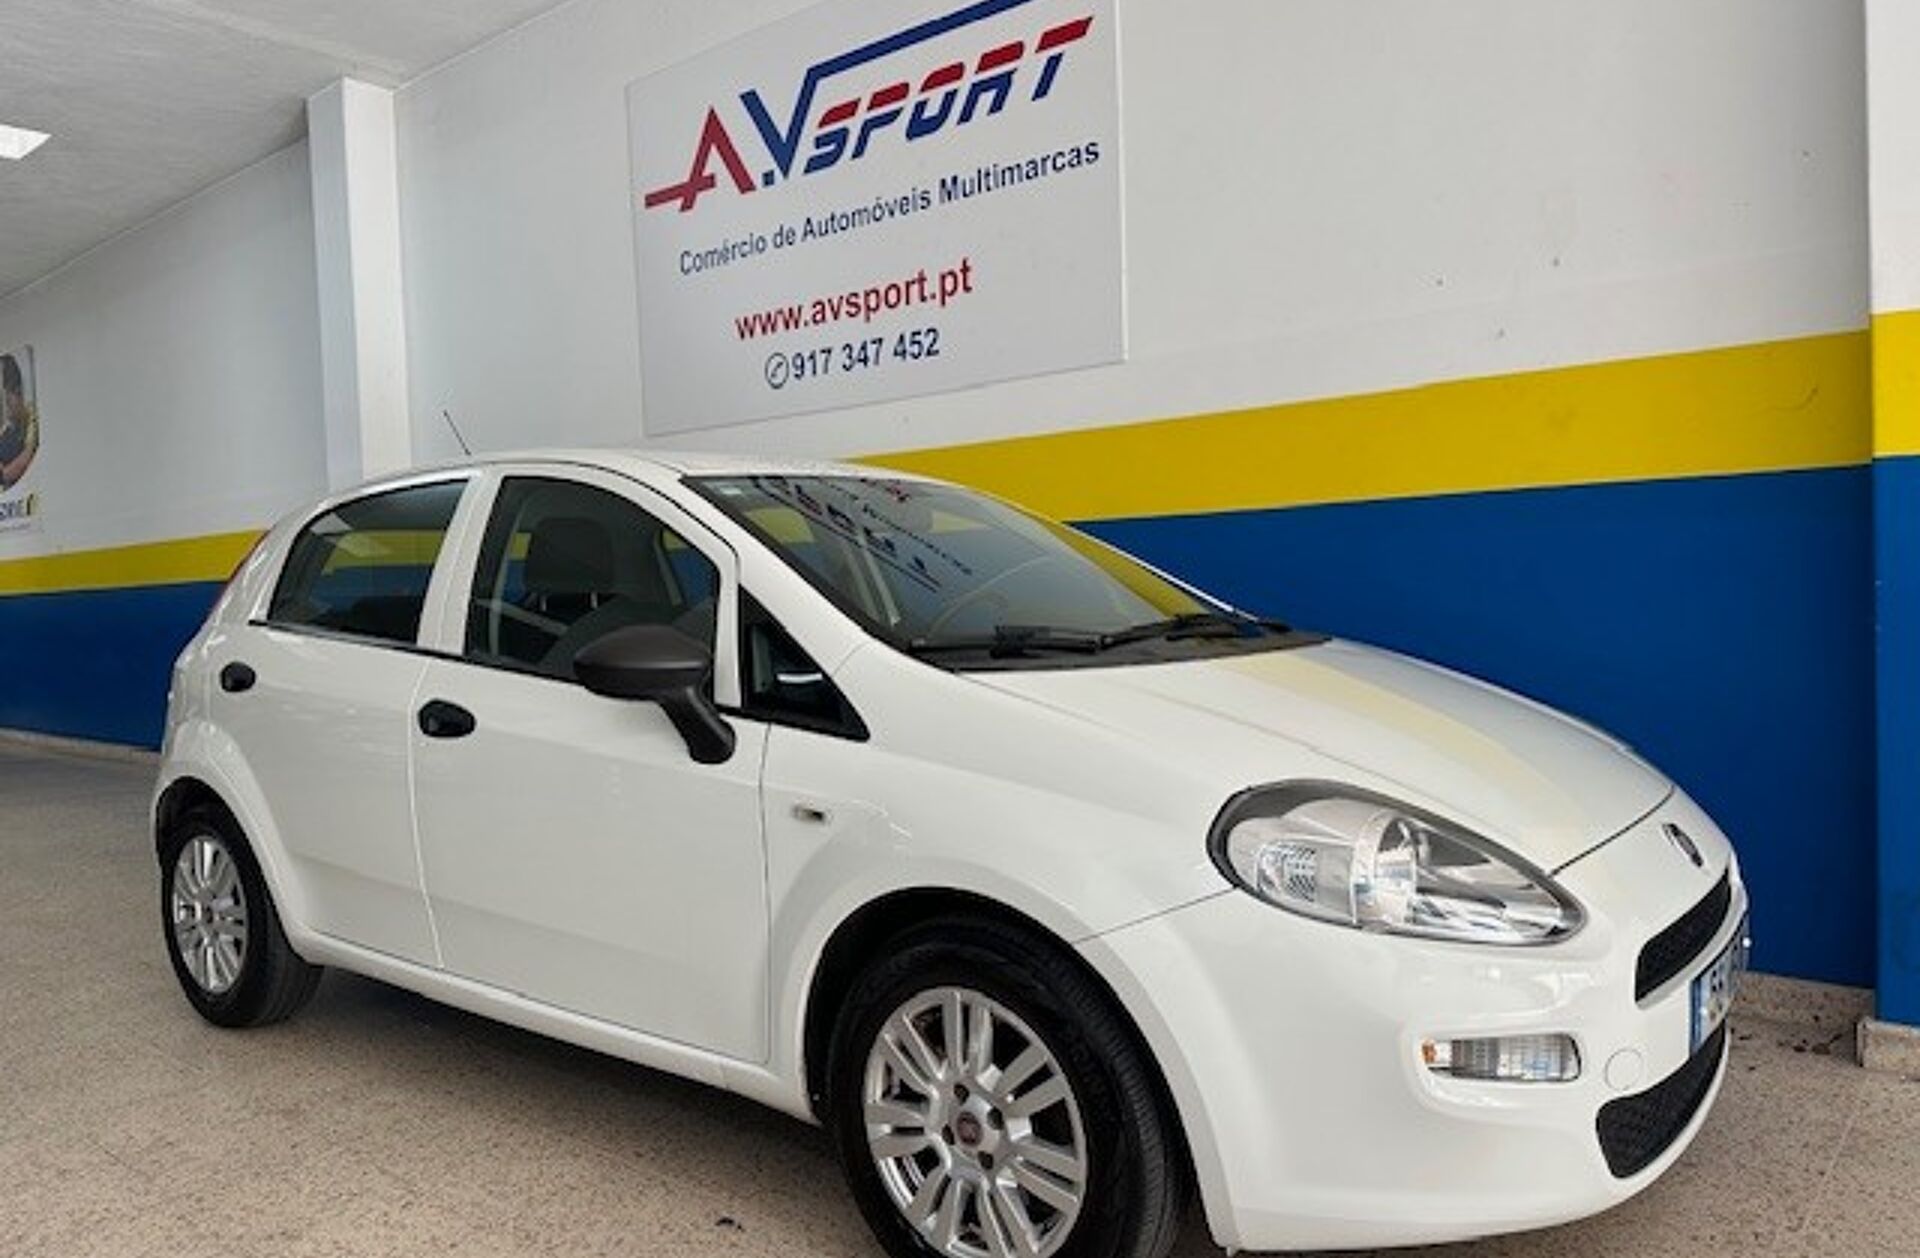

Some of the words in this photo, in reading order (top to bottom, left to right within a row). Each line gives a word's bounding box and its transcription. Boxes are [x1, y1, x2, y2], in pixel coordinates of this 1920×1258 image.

[679, 232, 768, 276] Comércio
[772, 223, 797, 249] de
[800, 187, 932, 242] Automóveis
[938, 141, 1100, 204] Multimarcas
[734, 256, 974, 341] www.avsport.pt
[791, 349, 833, 381] 917
[842, 337, 884, 372] 347
[892, 327, 941, 361] 452
